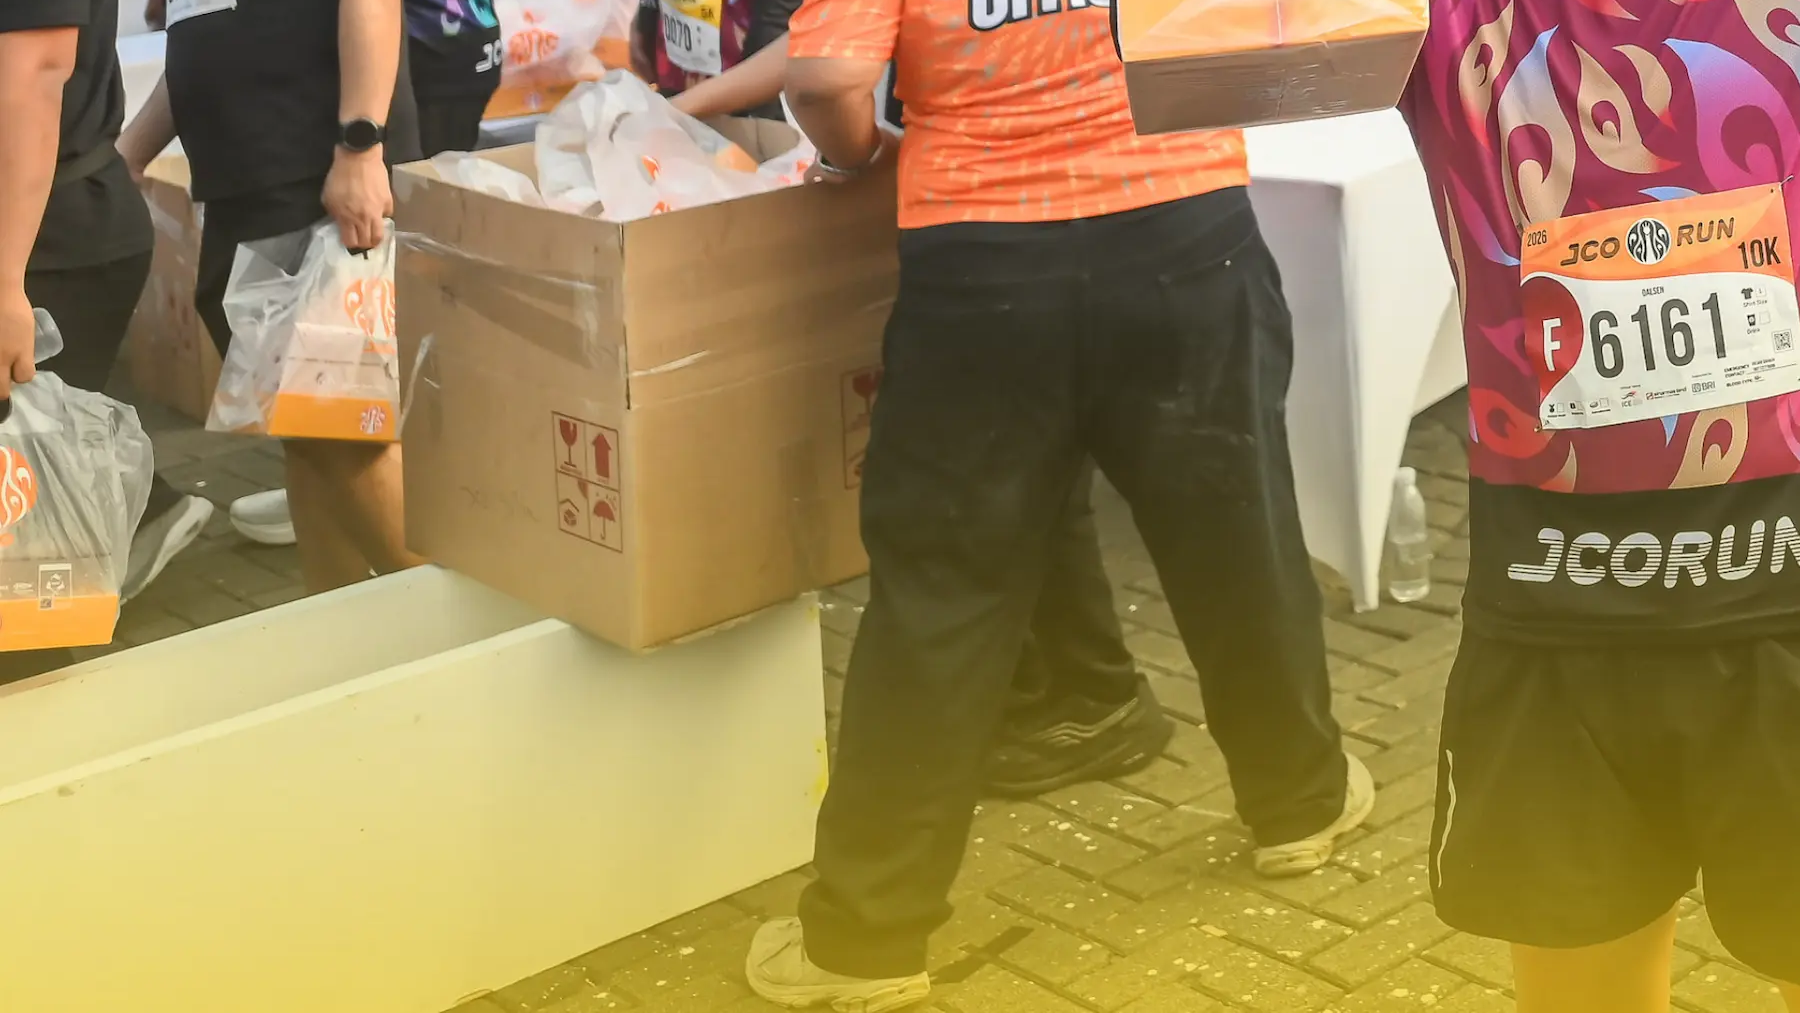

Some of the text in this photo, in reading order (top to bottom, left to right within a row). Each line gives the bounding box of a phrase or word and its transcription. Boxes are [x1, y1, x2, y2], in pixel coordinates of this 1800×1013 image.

[1527, 216, 1735, 266] 2026 JCO RUN
[1738, 236, 1781, 269] 10K
[1542, 292, 1726, 378] F 6161
[1702, 381, 1716, 391] BRI
